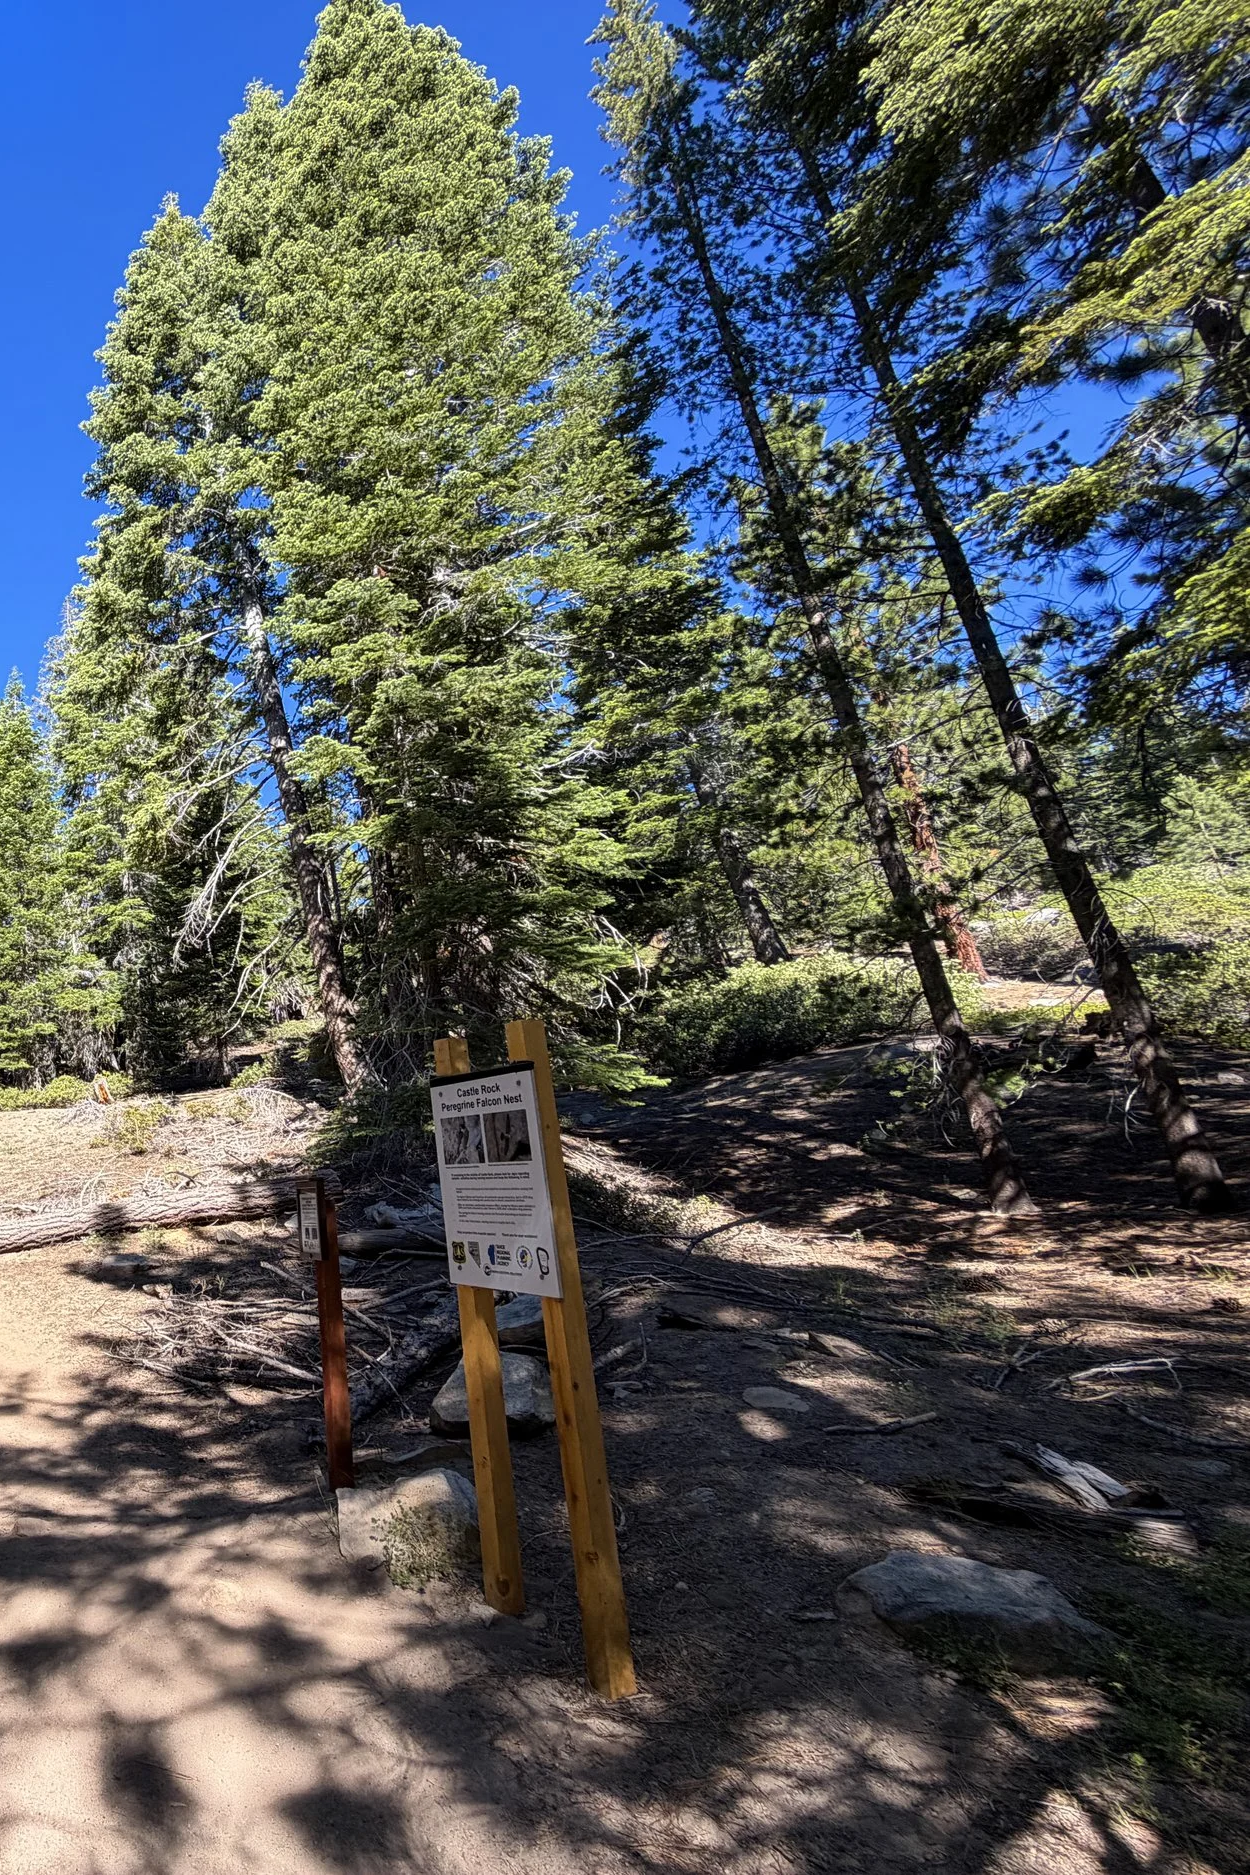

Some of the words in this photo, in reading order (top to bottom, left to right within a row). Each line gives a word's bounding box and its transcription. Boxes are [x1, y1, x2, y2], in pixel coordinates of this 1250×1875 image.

[457, 1086, 480, 1098] Castle
[481, 1083, 501, 1094] Rock
[441, 1100, 475, 1112] Peregrine
[476, 1097, 502, 1107] Falcon
[503, 1094, 522, 1104] Nest
